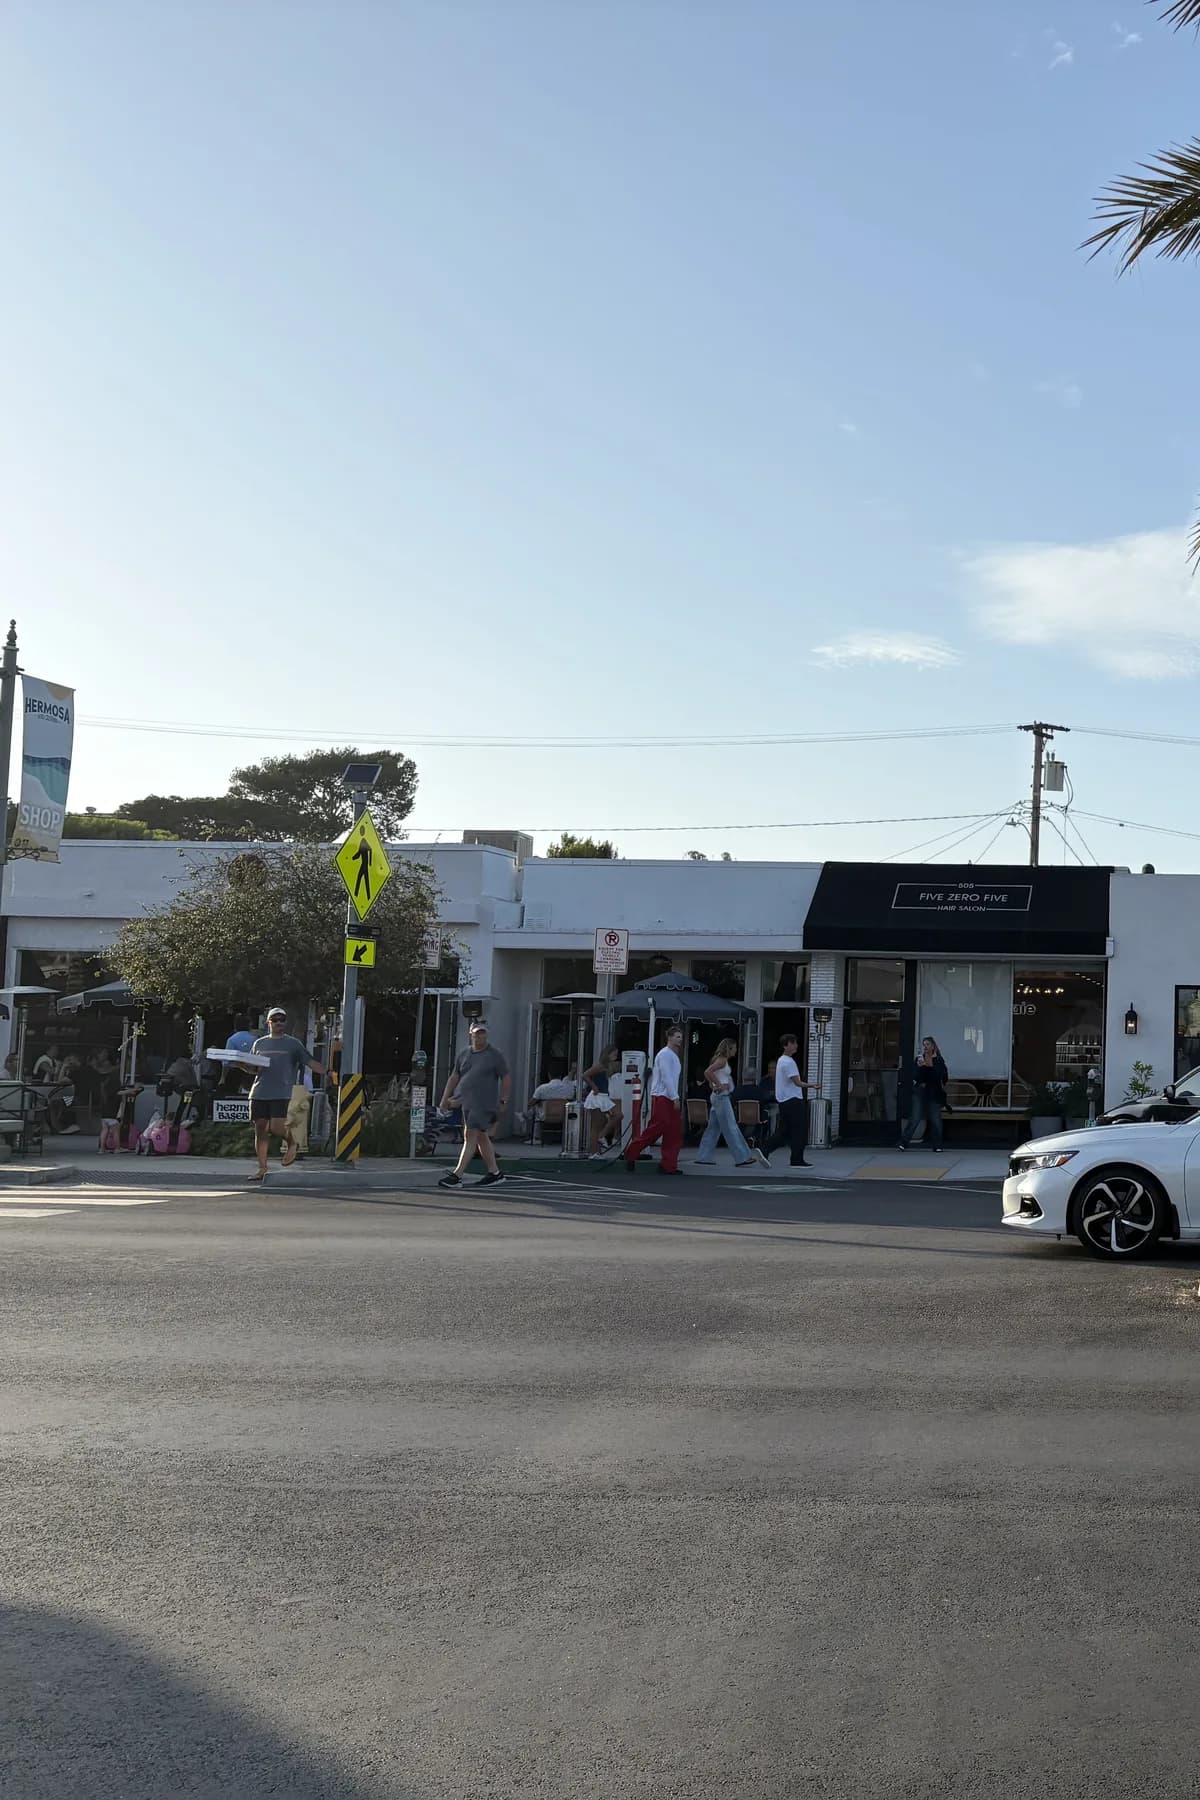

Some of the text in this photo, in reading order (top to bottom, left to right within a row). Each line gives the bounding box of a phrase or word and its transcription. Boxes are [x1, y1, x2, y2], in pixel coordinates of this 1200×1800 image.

[24, 697, 70, 725] HERMOSA
[20, 804, 61, 830] SHOP
[919, 892, 1009, 903] FIVE ZERO FIVE
